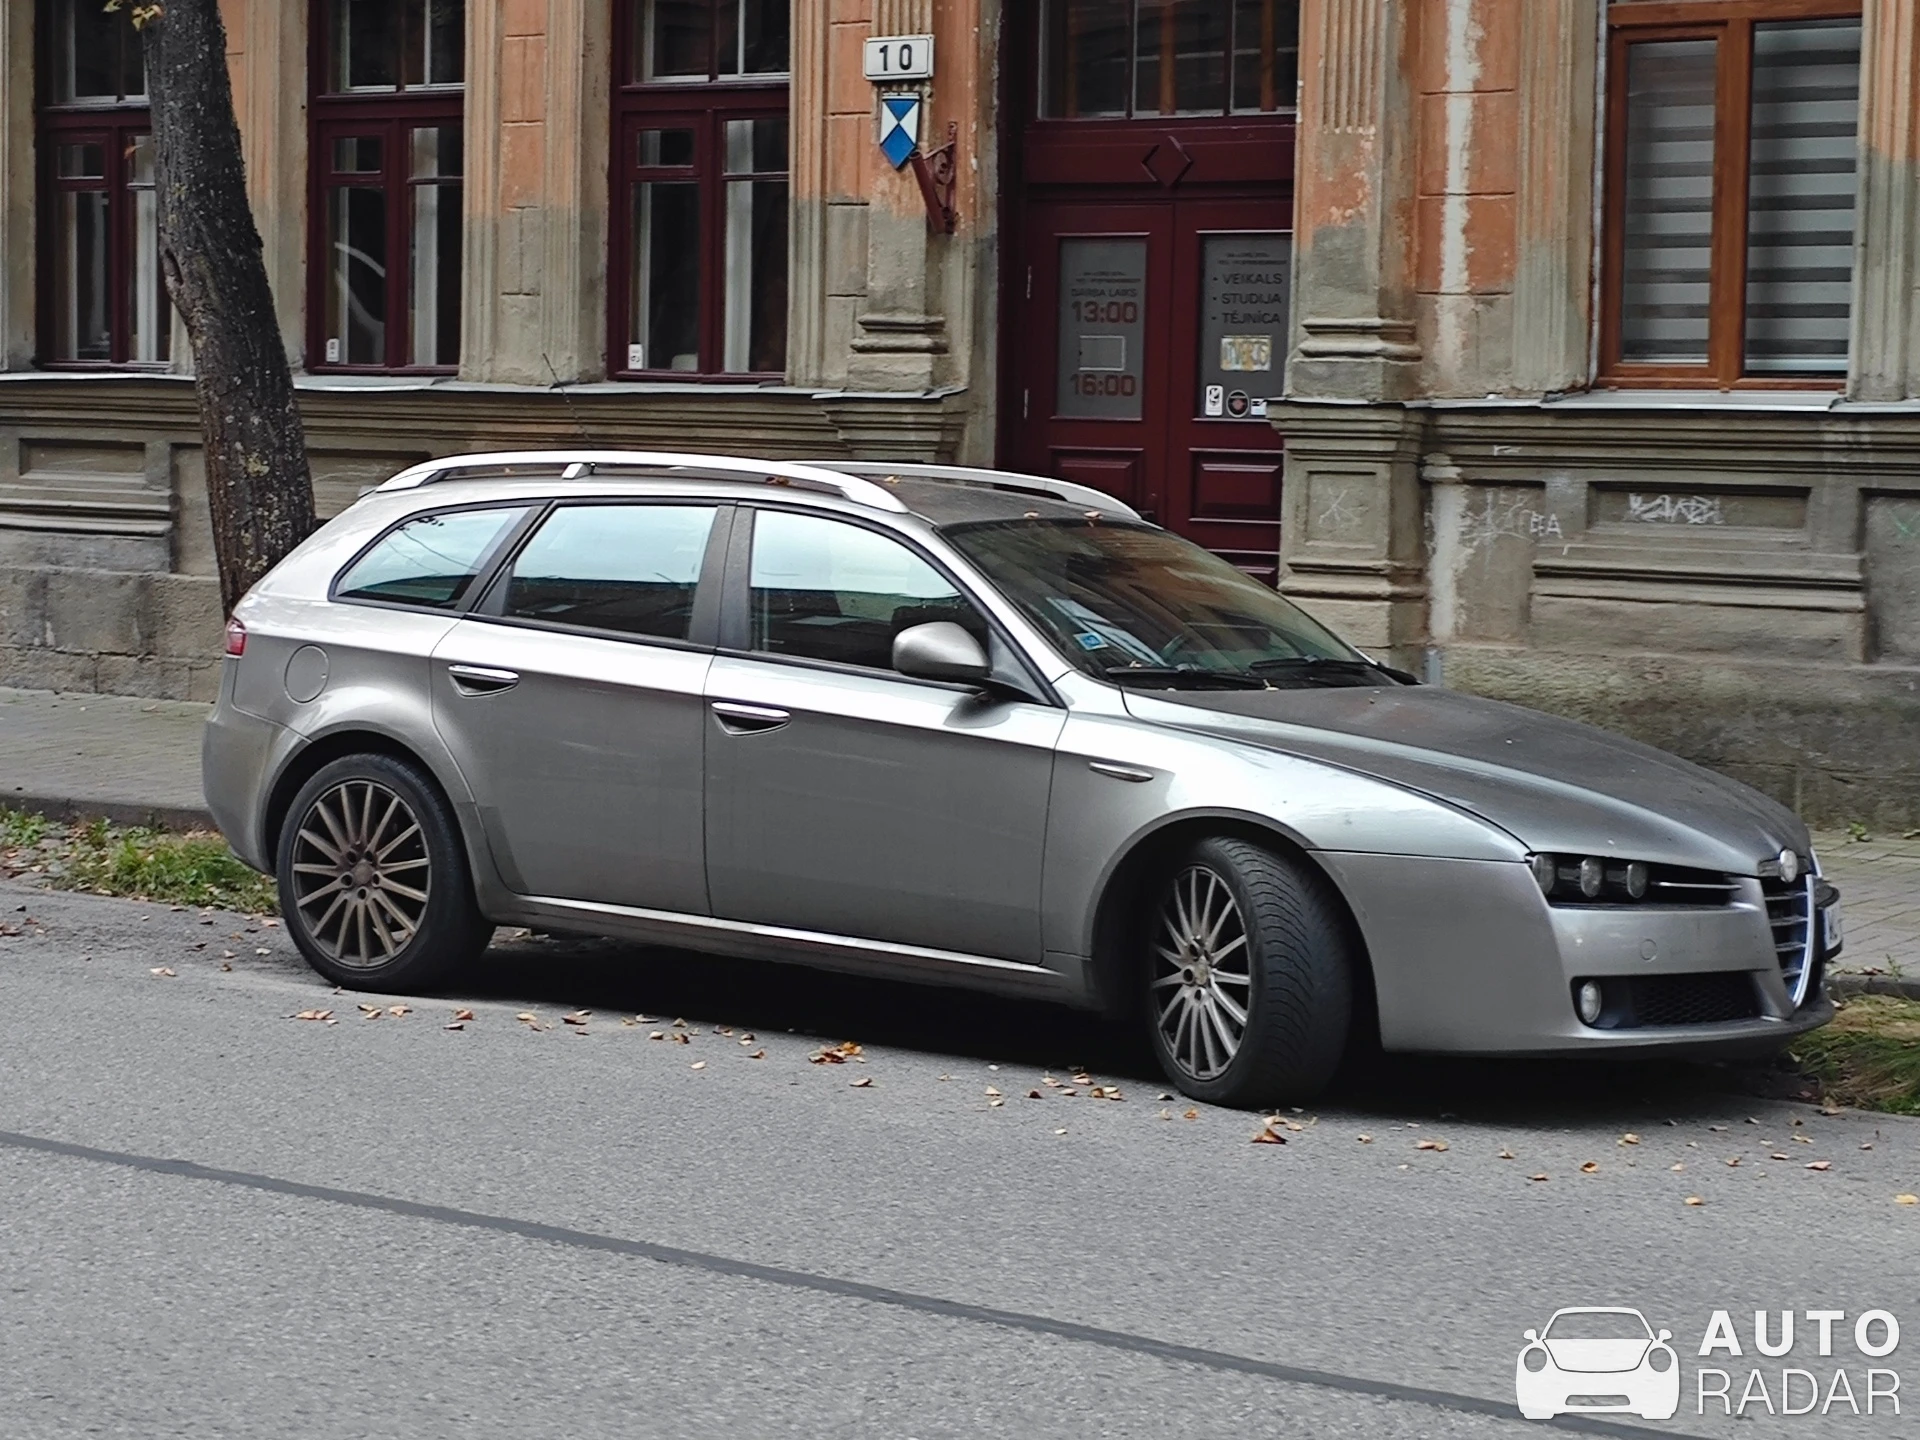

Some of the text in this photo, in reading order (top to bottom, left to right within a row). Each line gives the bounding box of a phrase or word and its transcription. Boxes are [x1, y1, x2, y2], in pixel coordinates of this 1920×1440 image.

[879, 43, 912, 71] 10
[1222, 273, 1282, 284] VEIKALS
[1221, 293, 1281, 304] STUDIJA
[1072, 301, 1137, 323] 13:00
[1070, 373, 1136, 396] 16:00
